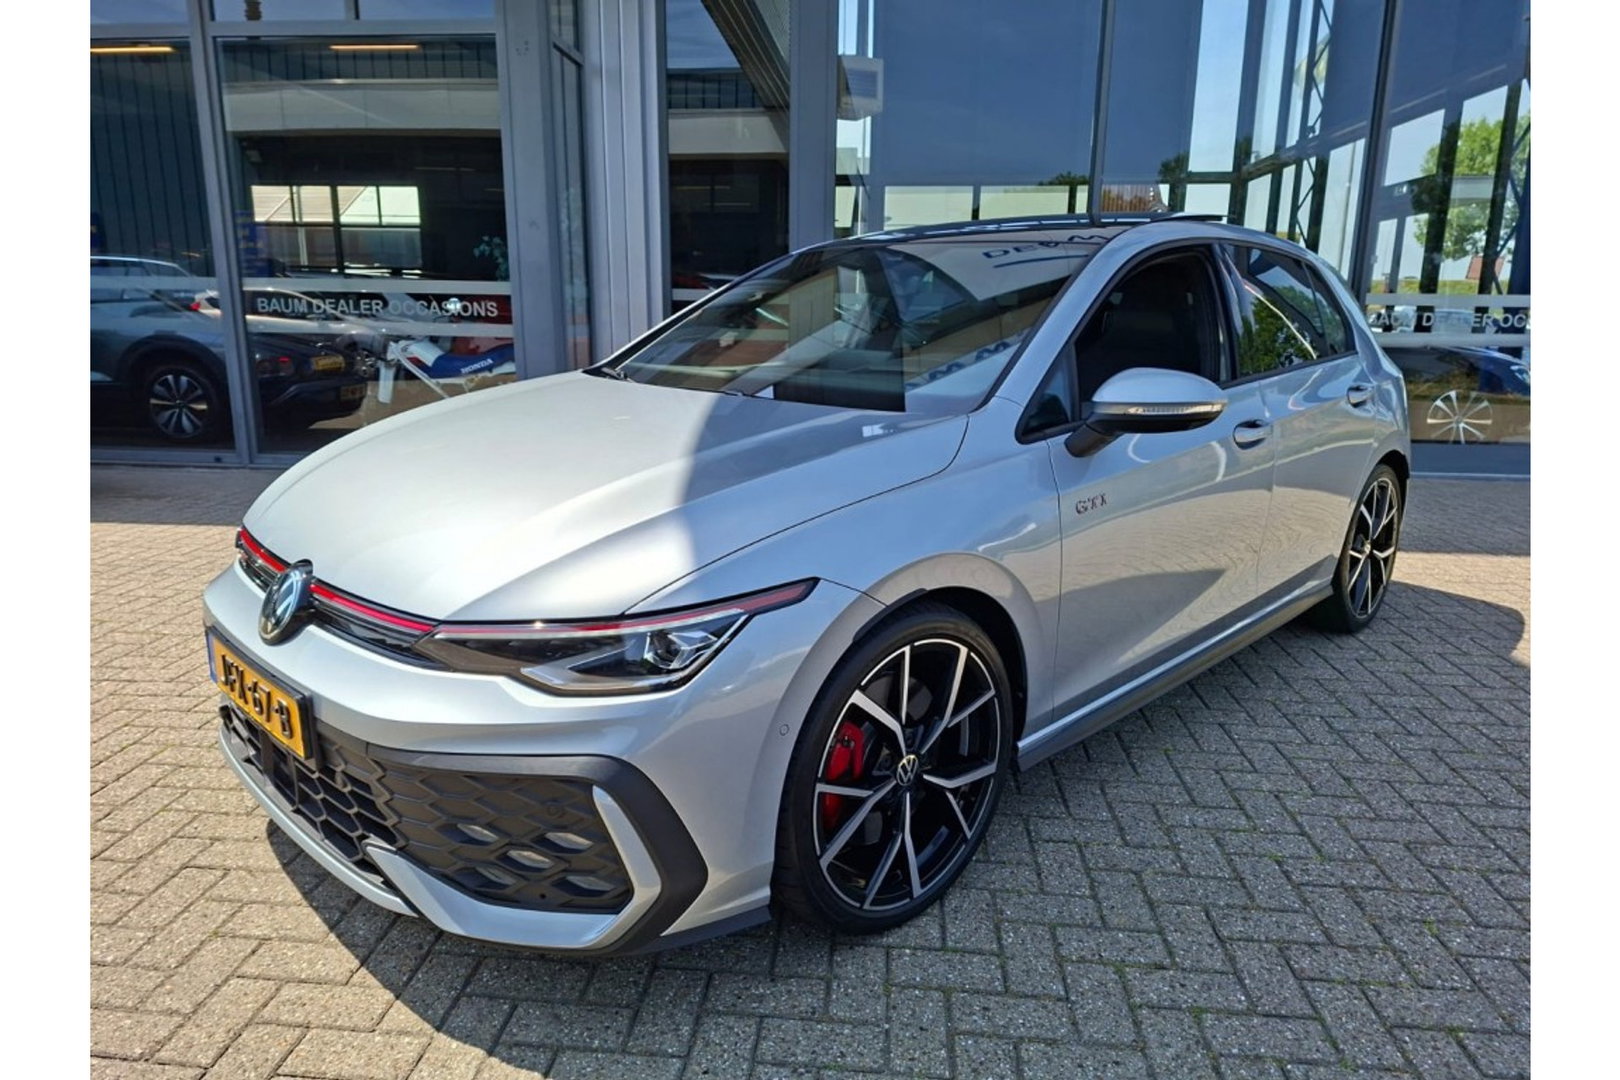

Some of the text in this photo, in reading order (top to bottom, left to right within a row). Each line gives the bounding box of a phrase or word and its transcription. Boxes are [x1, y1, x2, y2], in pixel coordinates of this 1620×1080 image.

[257, 298, 500, 317] BAUM DEALER OCCASIONS
[1499, 313, 1531, 328] OC
[460, 358, 494, 374] HONDA
[1075, 493, 1107, 515] GTI
